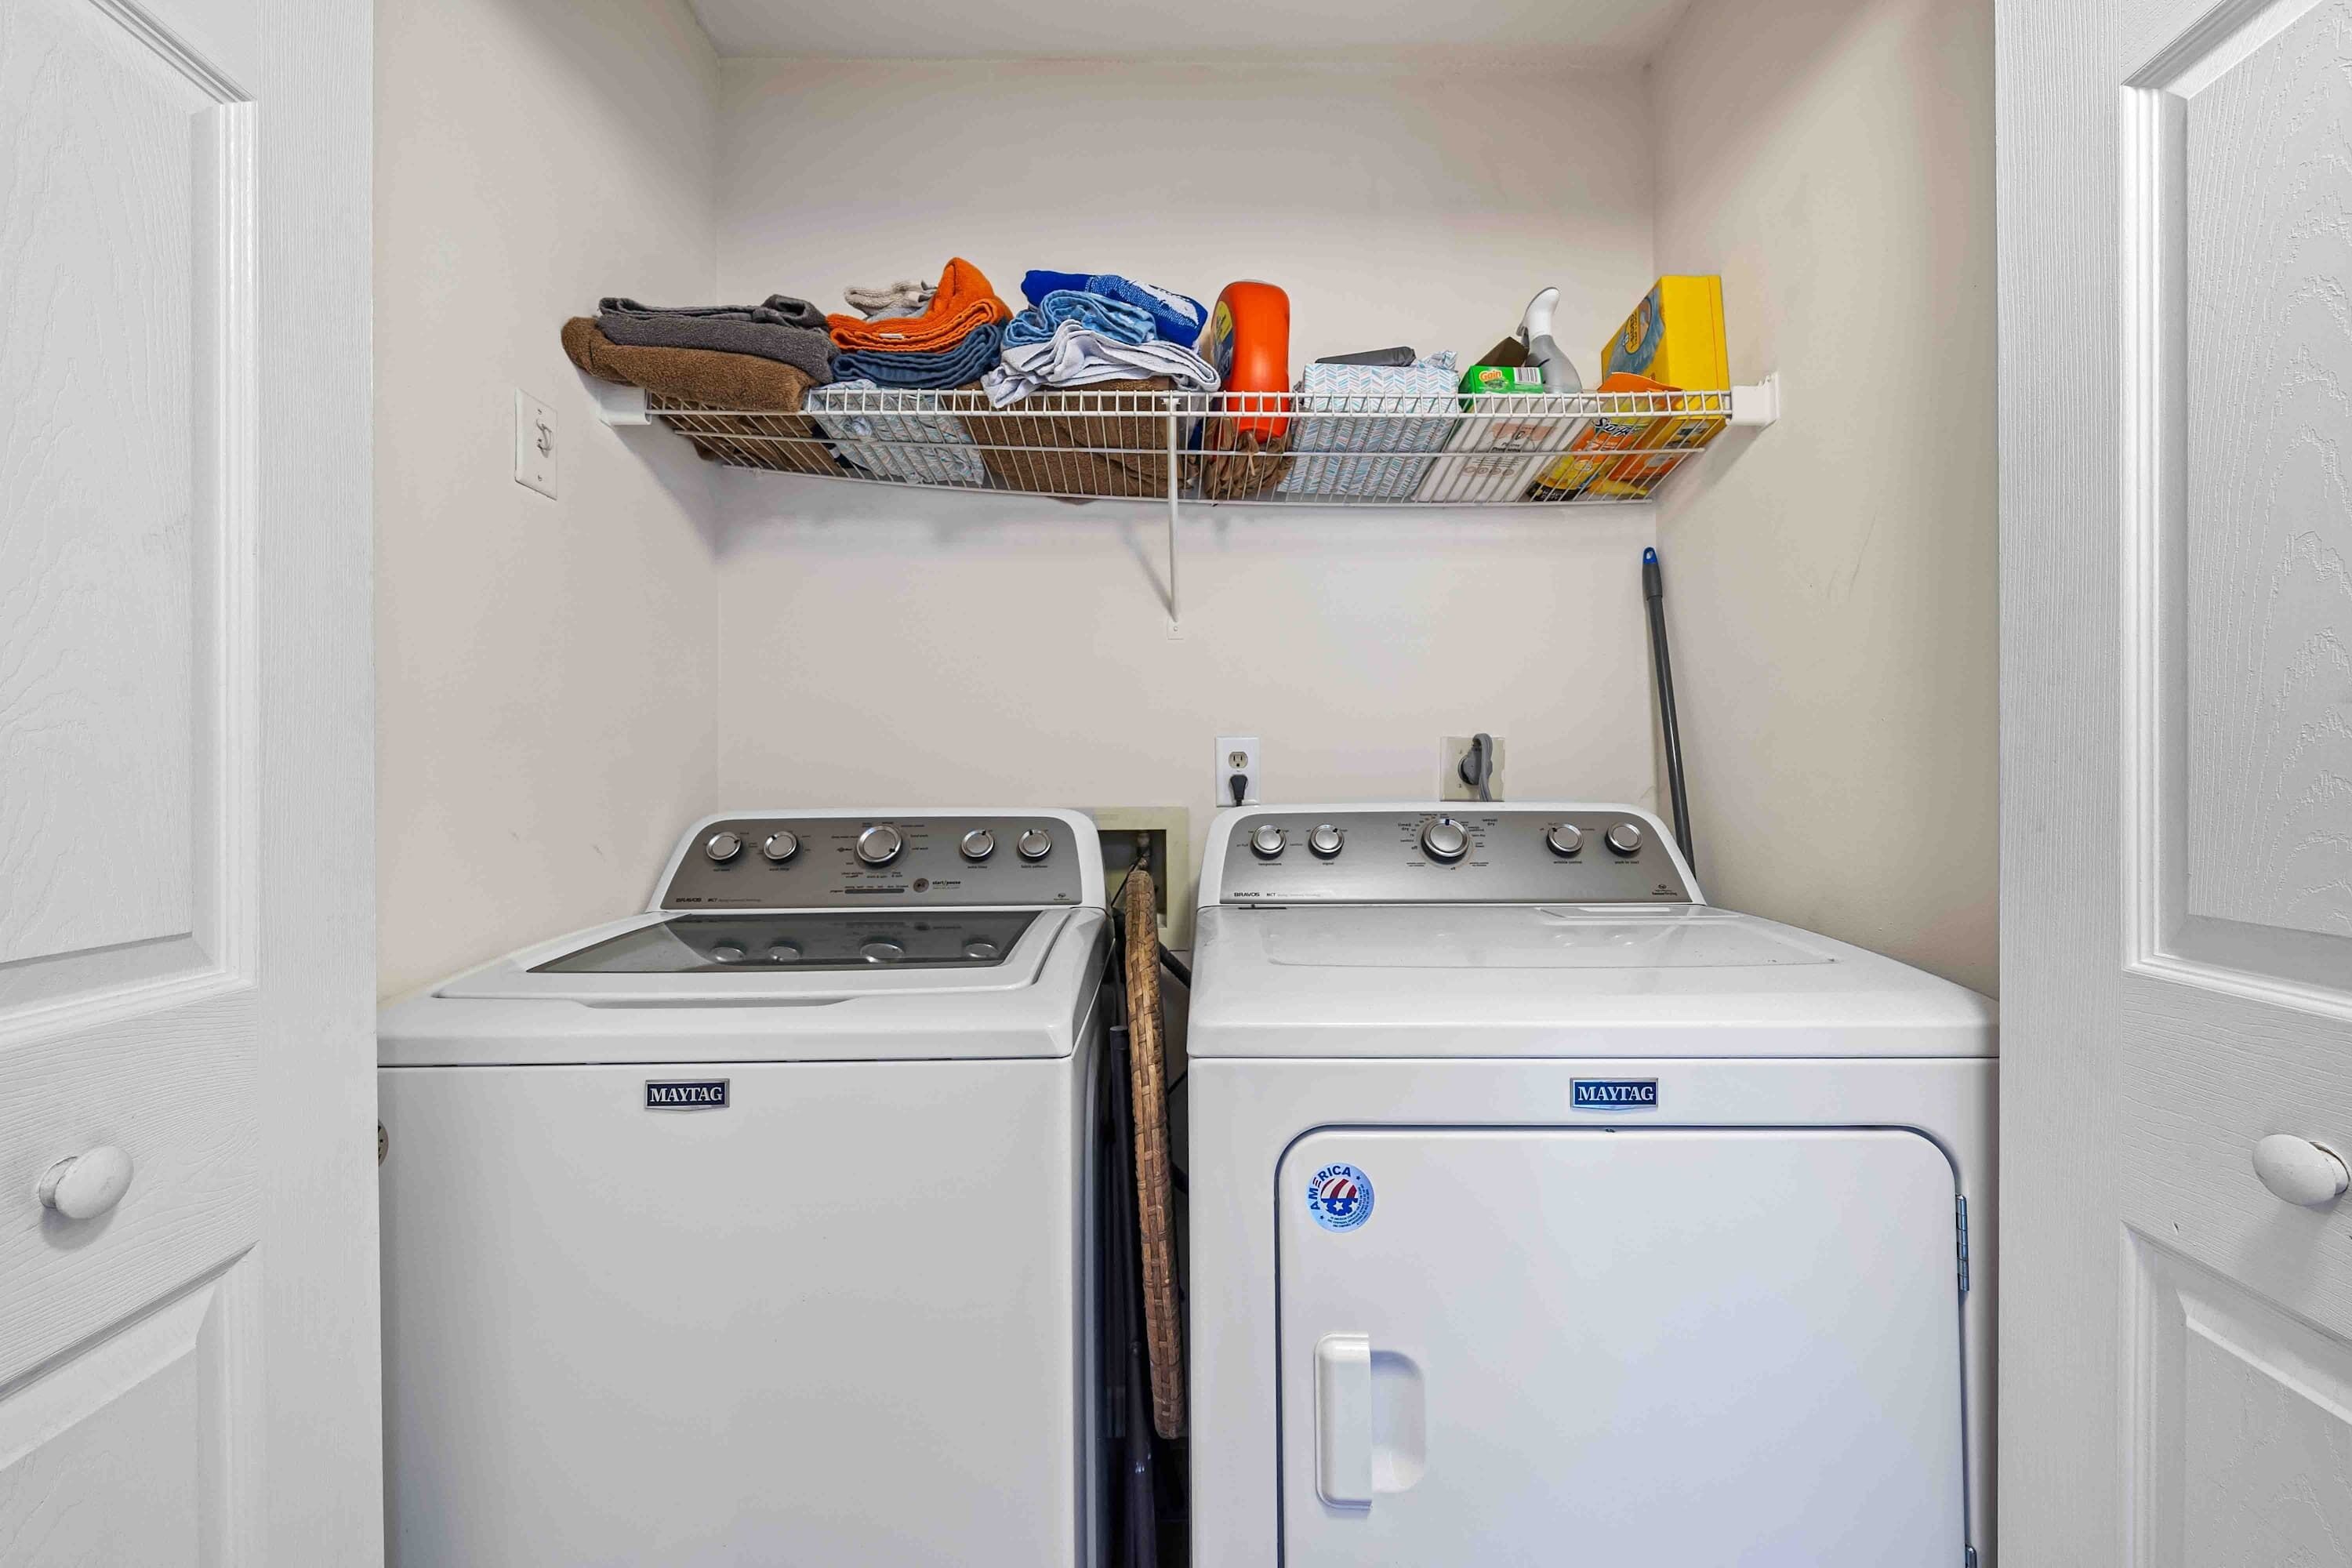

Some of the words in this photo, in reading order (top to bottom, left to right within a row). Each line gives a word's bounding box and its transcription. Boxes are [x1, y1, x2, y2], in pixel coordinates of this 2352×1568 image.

[1479, 370, 1502, 382] Gain
[649, 1087, 723, 1102] MAYTAG
[1577, 1086, 1654, 1101] MAYTAG
[1308, 1165, 1352, 1210] AMERICA
